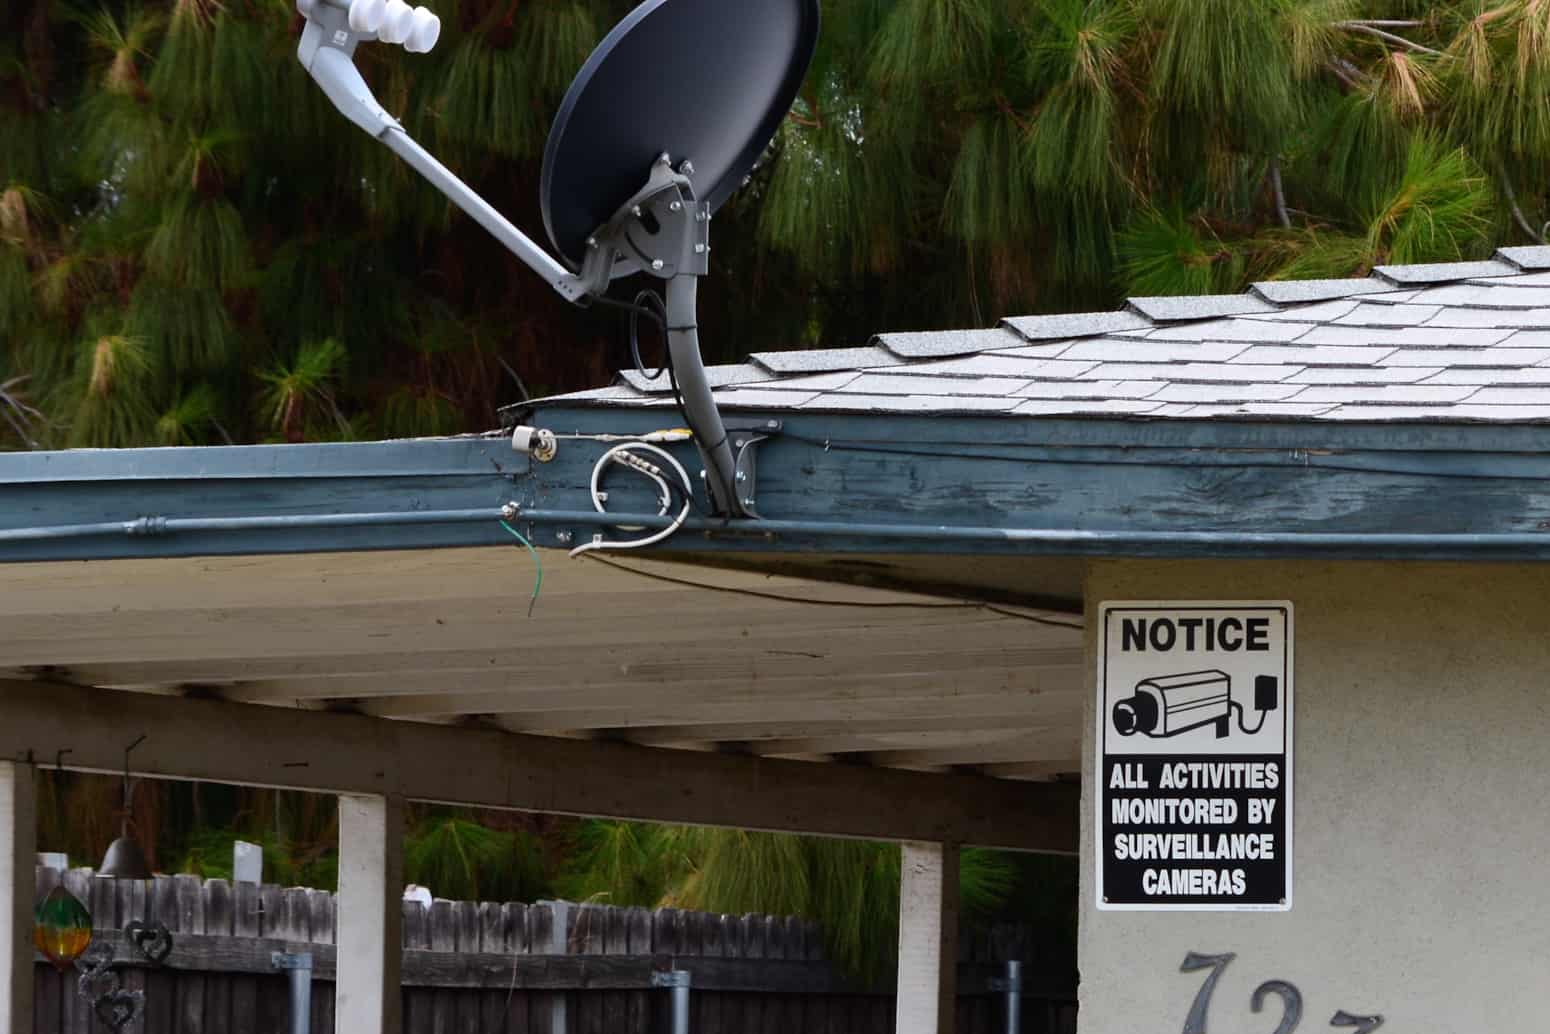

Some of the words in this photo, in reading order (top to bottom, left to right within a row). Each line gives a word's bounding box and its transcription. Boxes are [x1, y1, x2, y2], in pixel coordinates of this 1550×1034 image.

[1122, 618, 1269, 651] NOTICE
[1110, 763, 1148, 789] ALL
[1160, 763, 1280, 789] ACTIVITIES
[1112, 798, 1238, 824] MONITORED
[1248, 798, 1276, 824] BY
[1114, 833, 1274, 860] SURVEILLANCE
[1143, 868, 1246, 895] CAMERAS
